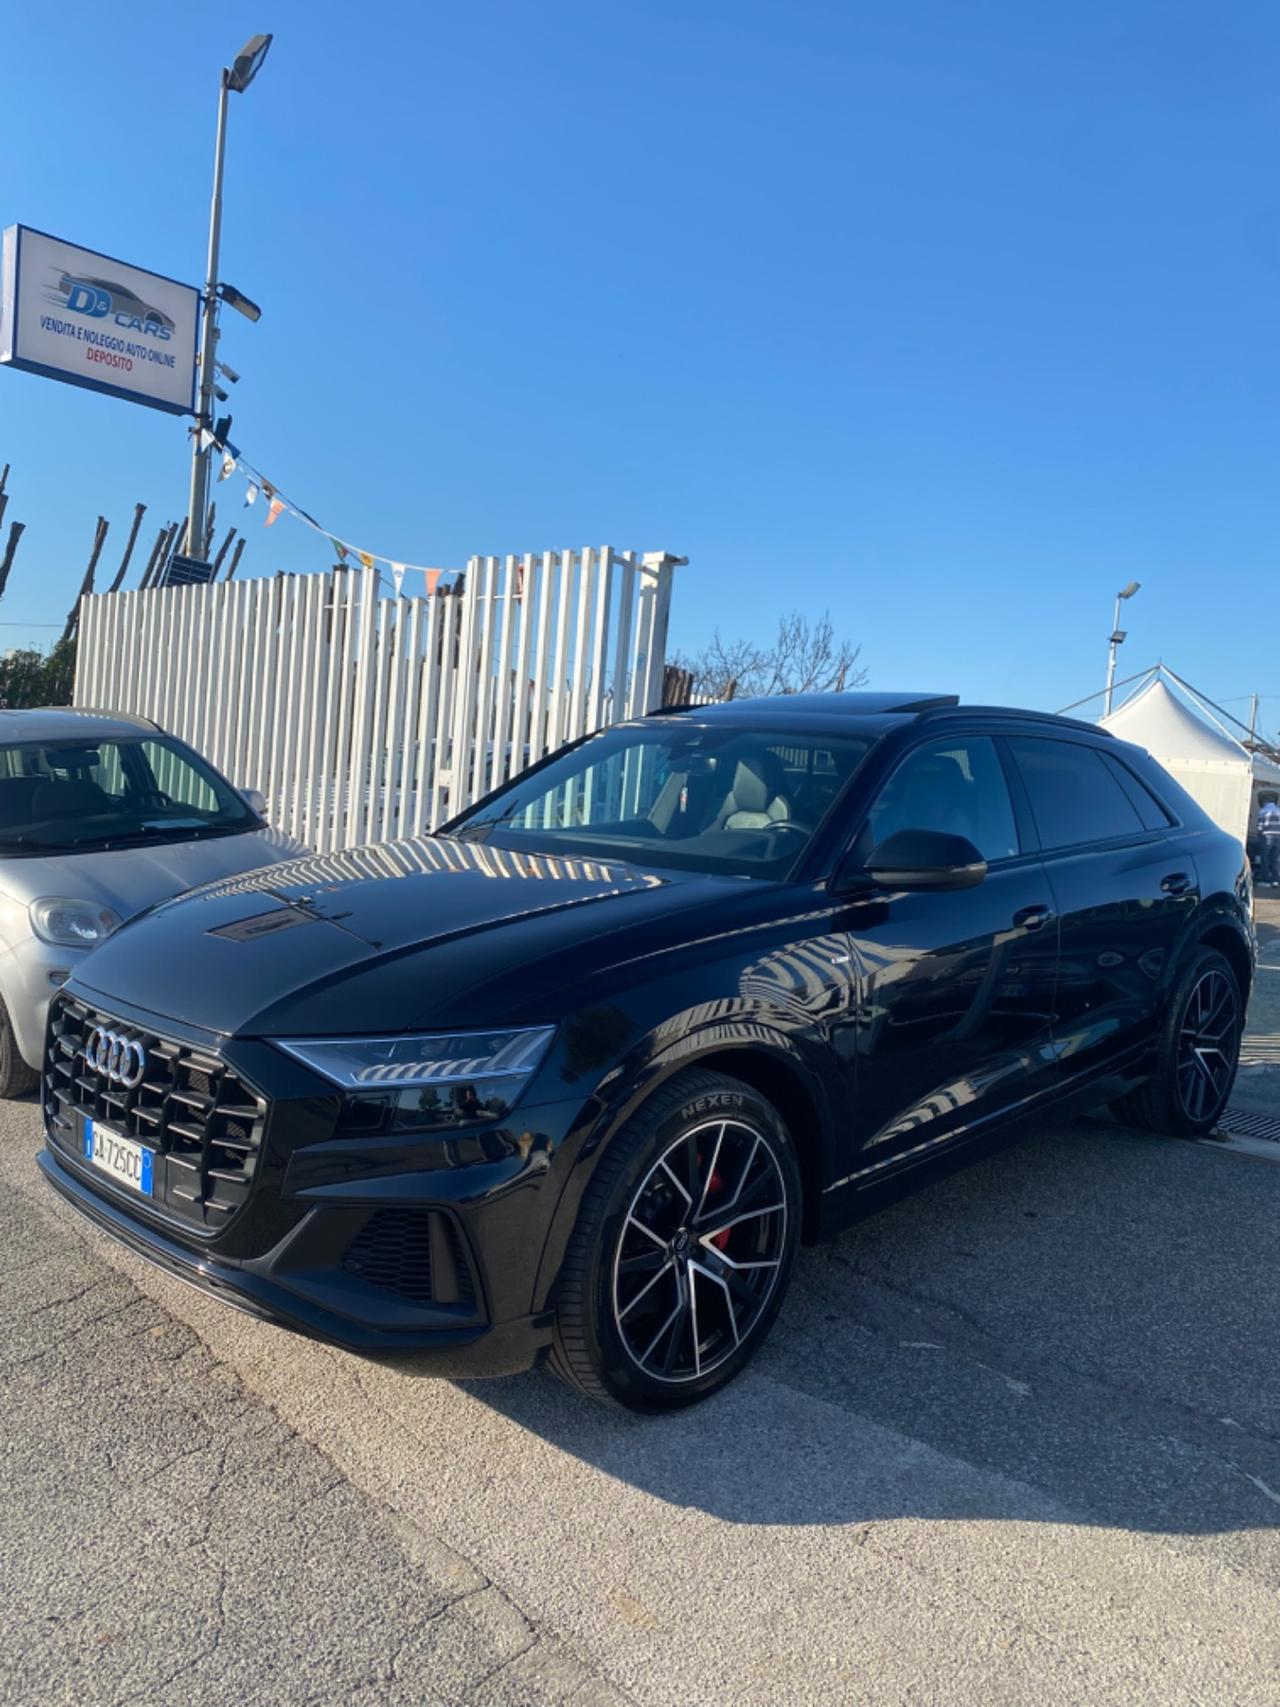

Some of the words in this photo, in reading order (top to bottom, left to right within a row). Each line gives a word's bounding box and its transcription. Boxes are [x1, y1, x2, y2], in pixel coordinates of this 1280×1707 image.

[114, 311, 172, 341] CARS
[41, 315, 76, 338] VENDITA
[77, 327, 82, 340] E
[83, 328, 124, 353] NOLEGGIO
[126, 341, 147, 359] AUTO
[148, 348, 176, 368] ONLINE
[87, 347, 133, 372] DEPOSITO
[680, 1094, 743, 1120] NEXEN
